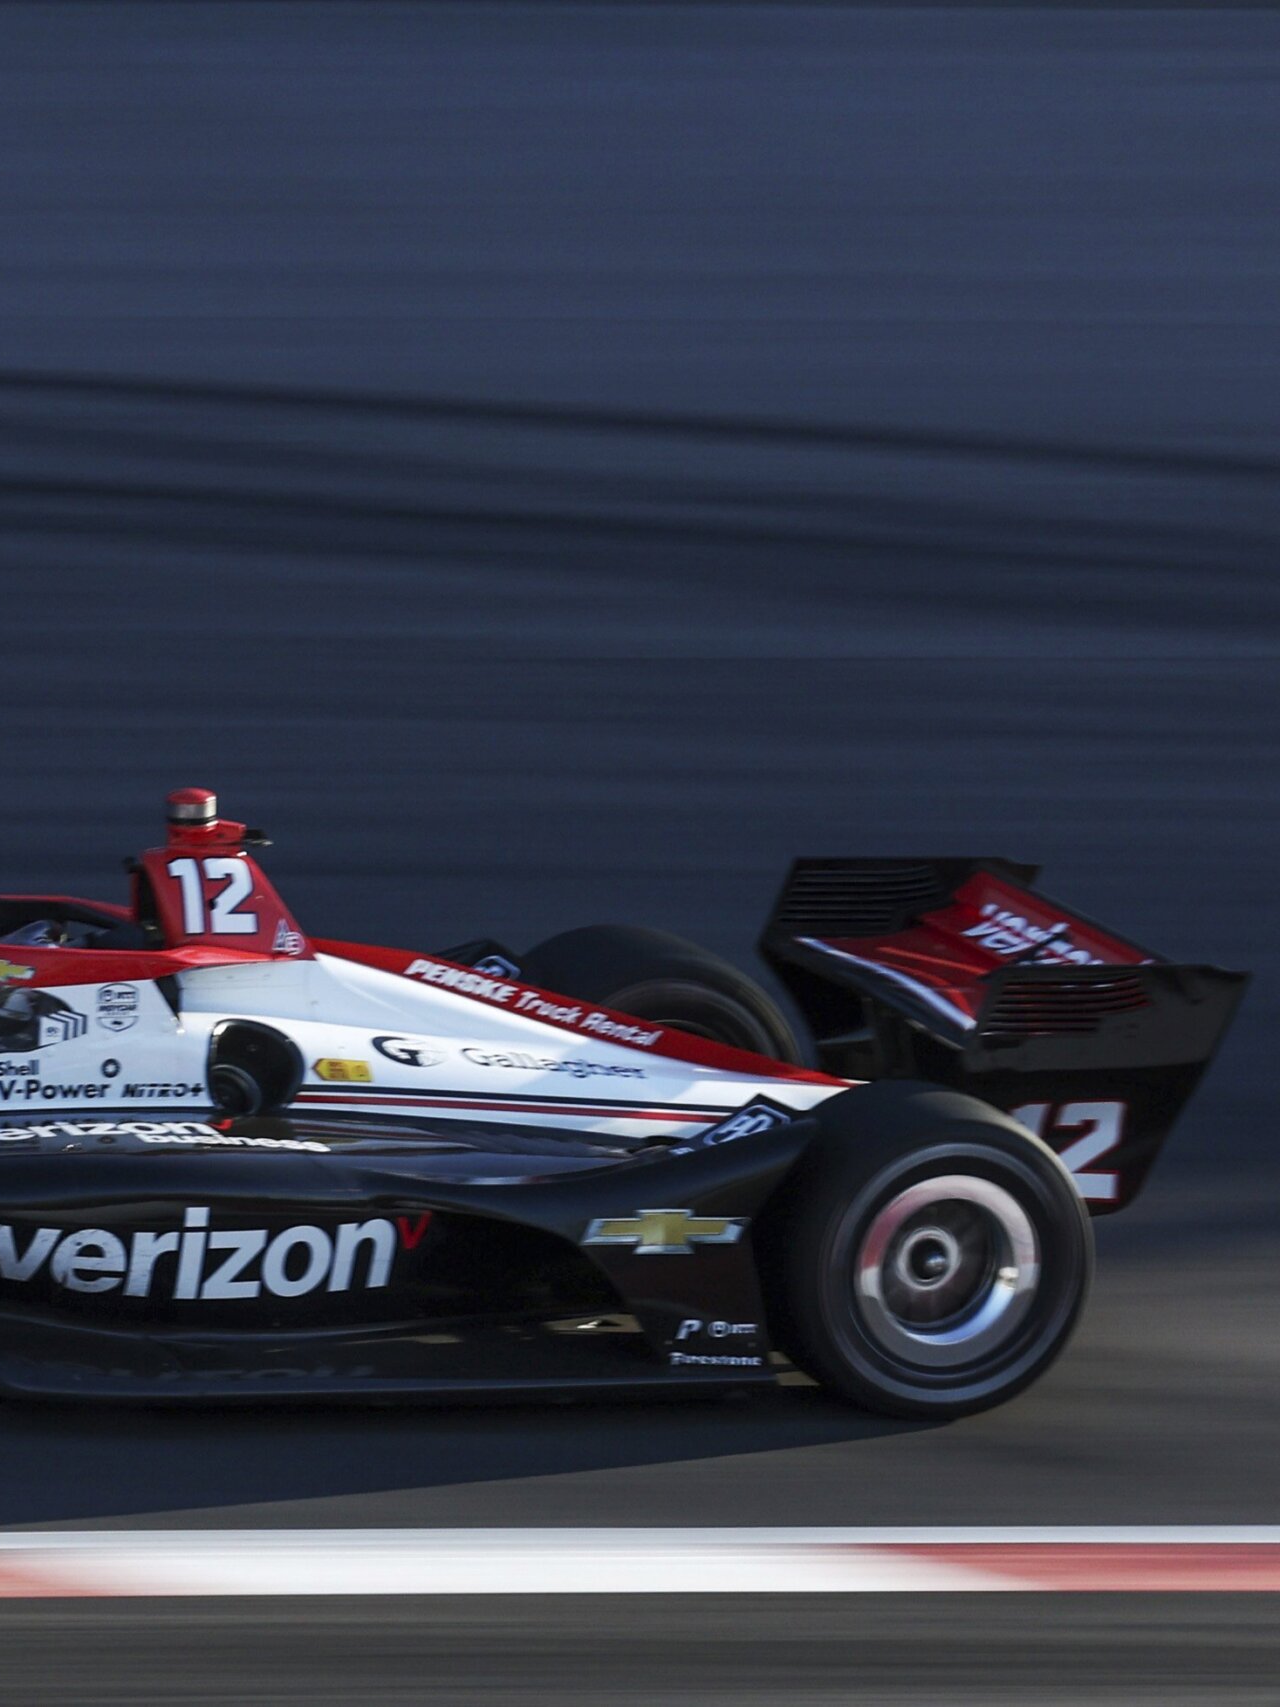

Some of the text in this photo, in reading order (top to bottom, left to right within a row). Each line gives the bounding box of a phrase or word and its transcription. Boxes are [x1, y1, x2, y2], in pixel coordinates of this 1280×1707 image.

[167, 857, 258, 934] 12
[404, 959, 664, 1046] PENSKE Truck Rental
[137, 1133, 332, 1152] business
